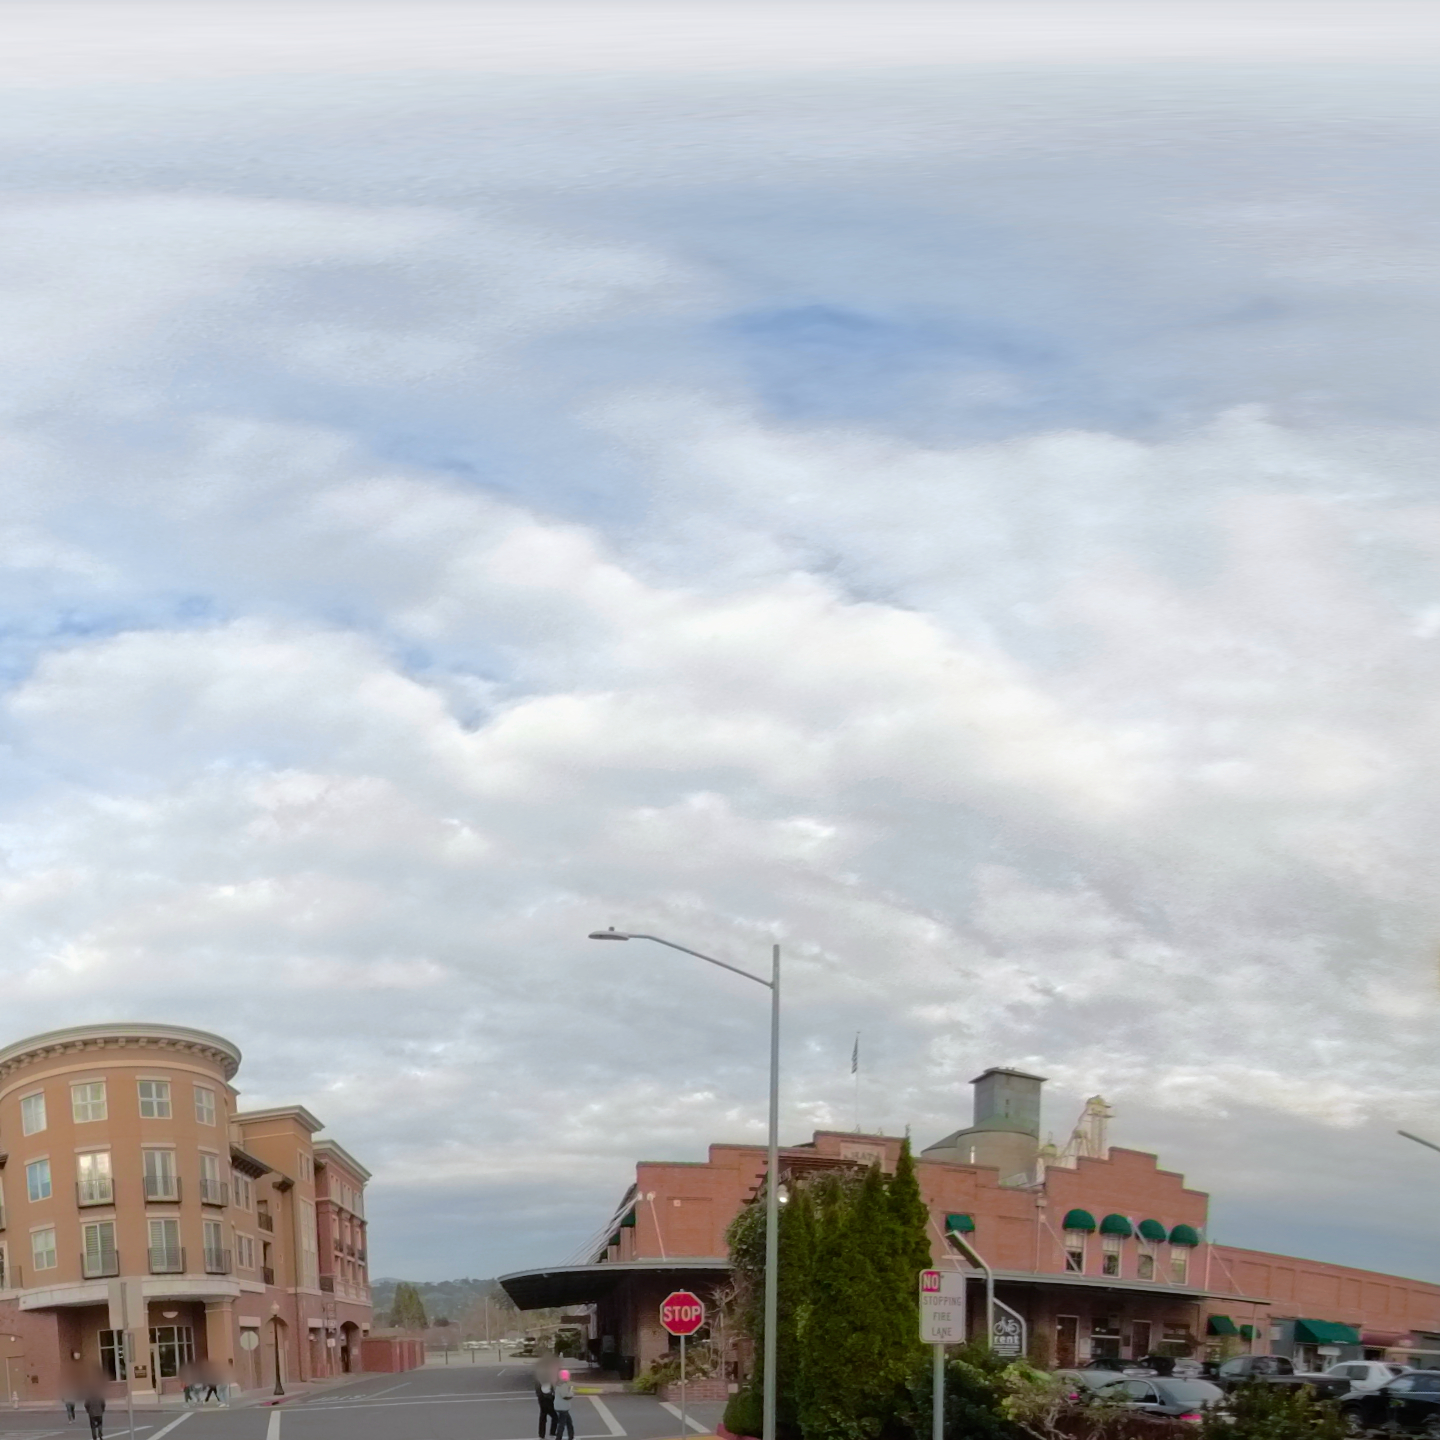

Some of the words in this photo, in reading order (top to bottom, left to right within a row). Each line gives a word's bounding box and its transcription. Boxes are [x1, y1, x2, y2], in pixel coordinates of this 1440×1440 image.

[923, 1274, 939, 1290] NO
[923, 1296, 962, 1306] STOPPING
[663, 1305, 701, 1322] STOP
[933, 1312, 952, 1321] FIRE
[932, 1327, 953, 1337] LANE
[994, 1335, 1020, 1344] rent
